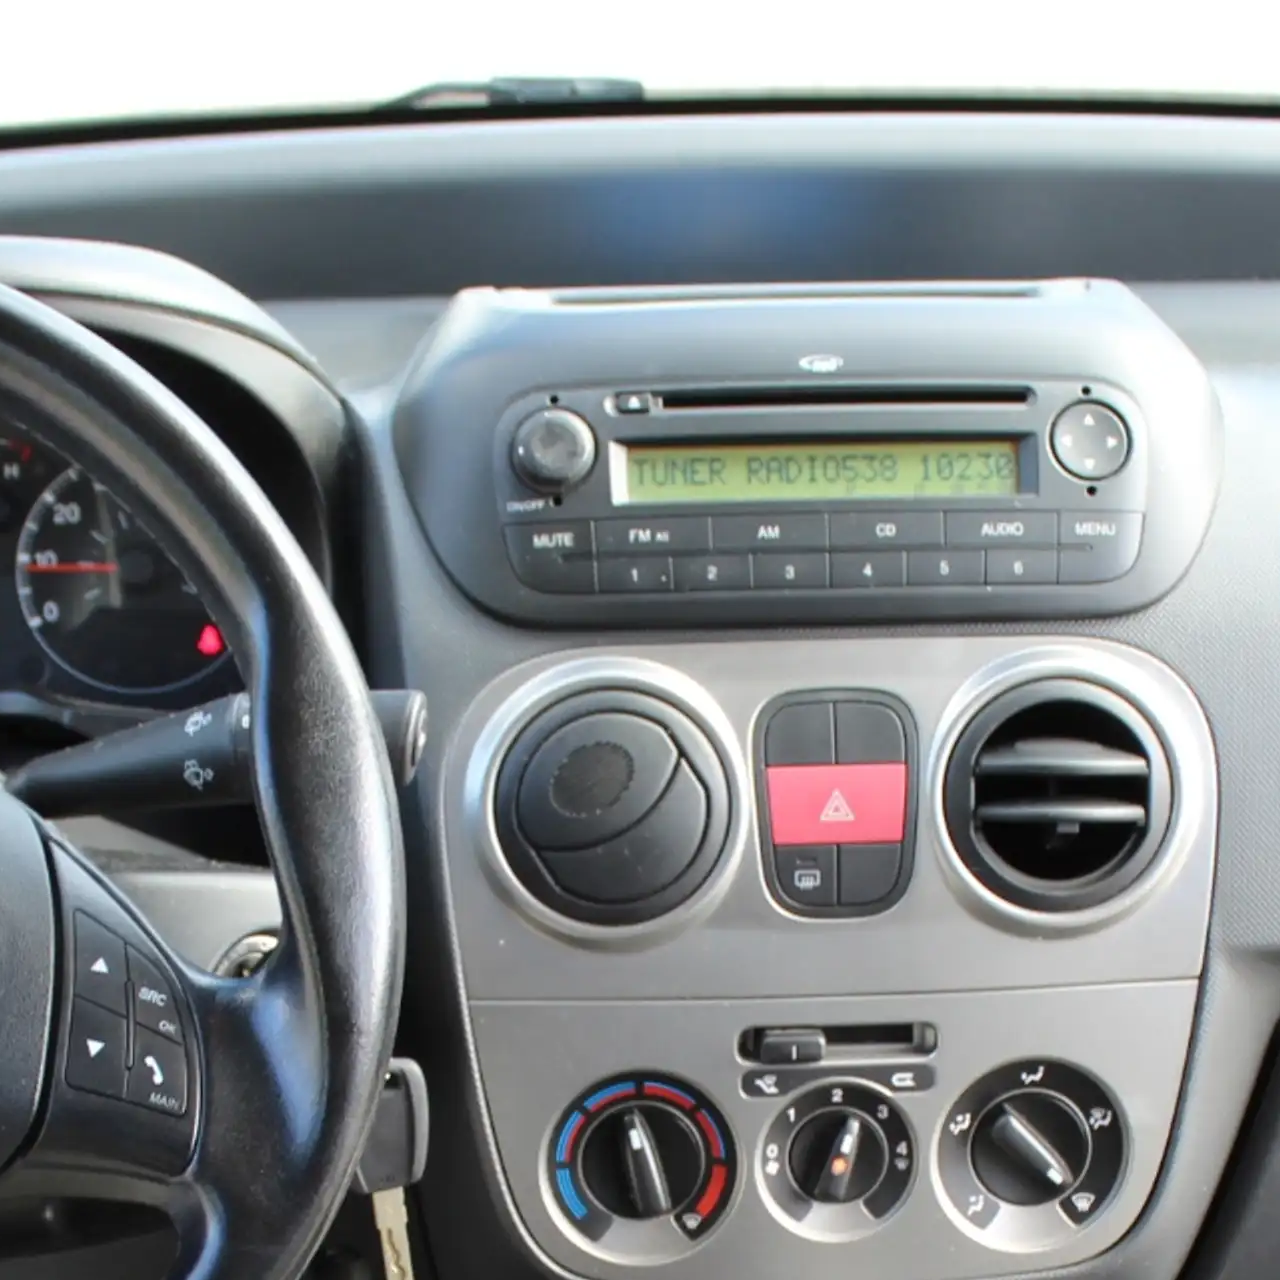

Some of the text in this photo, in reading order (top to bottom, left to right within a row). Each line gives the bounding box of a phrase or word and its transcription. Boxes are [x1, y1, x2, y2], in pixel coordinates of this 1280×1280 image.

[632, 456, 727, 486] TUNER
[52, 502, 81, 524] 20
[629, 528, 651, 543] FM
[757, 525, 780, 539] AM
[876, 522, 897, 537] CD
[980, 521, 1024, 537] AUDIO
[1075, 521, 1116, 537] MENU
[533, 533, 574, 548] MUTE
[706, 565, 718, 581] 2
[784, 564, 795, 580] 3
[862, 562, 873, 577] 4
[939, 560, 950, 576] 5
[1013, 560, 1024, 575] 6
[630, 568, 639, 583] 1
[832, 1088, 843, 1103] 2
[787, 1107, 795, 1123] 1
[877, 1104, 889, 1119] 3
[766, 1143, 779, 1159] 0
[896, 1141, 908, 1156] 4
